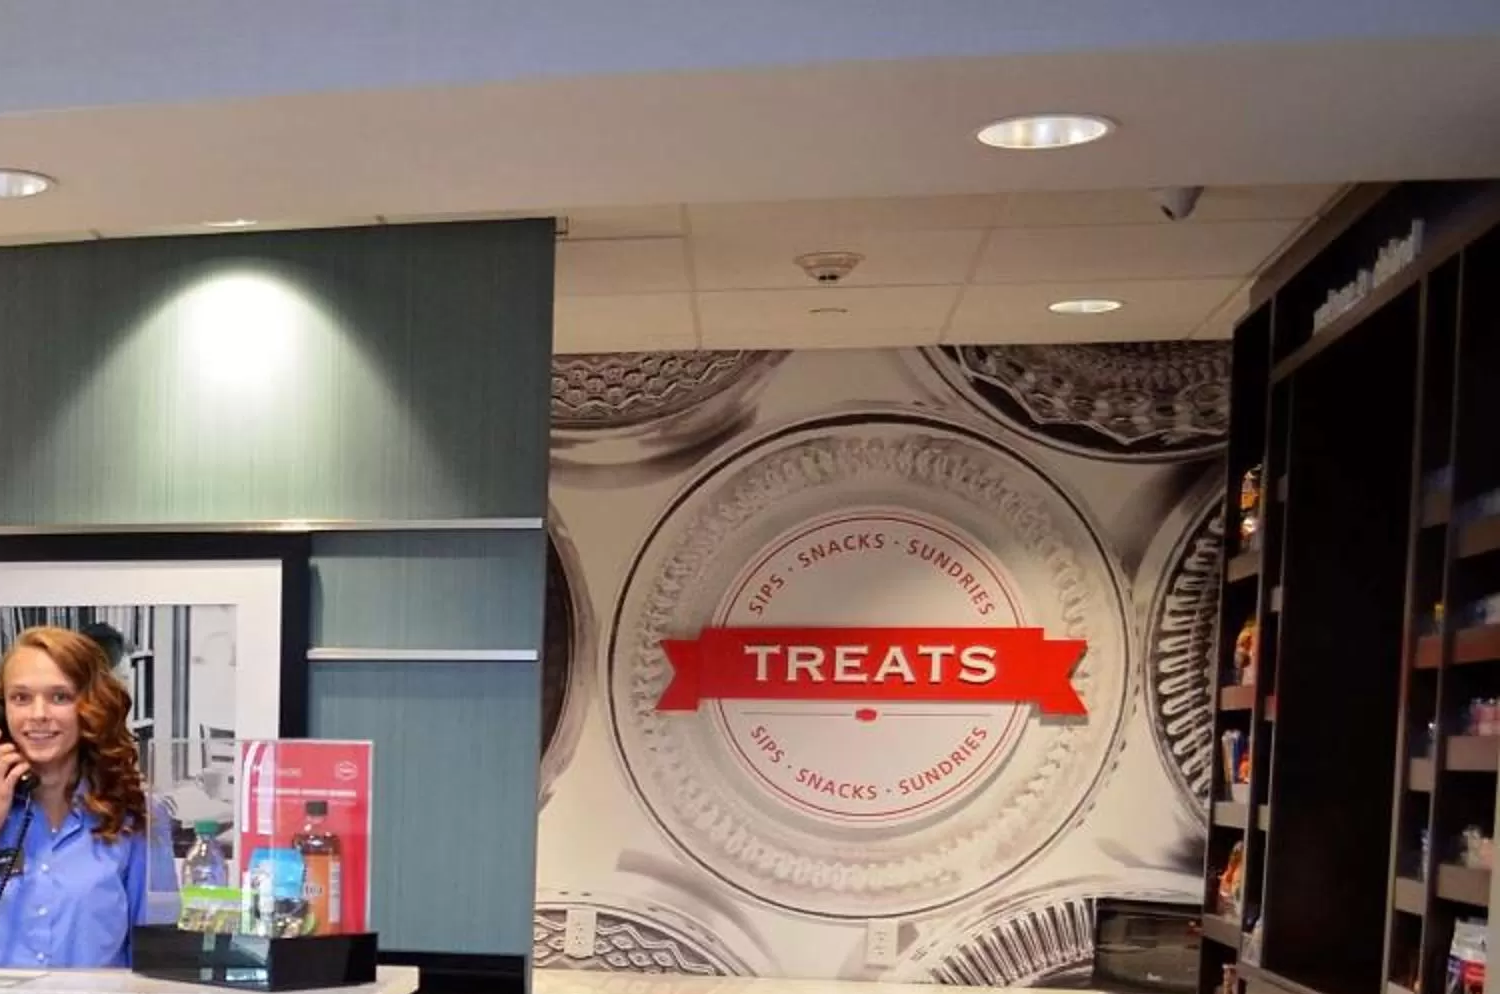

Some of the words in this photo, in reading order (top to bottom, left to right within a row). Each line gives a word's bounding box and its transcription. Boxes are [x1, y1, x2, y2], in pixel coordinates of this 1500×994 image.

[749, 573, 785, 616] SIPS
[798, 533, 885, 568] SNACKS
[906, 539, 996, 615] SUNDRIES
[744, 645, 998, 684] TREATS
[751, 726, 785, 764] SIPS
[796, 768, 877, 800] SNACKS
[899, 727, 988, 796] SUNDRIES
